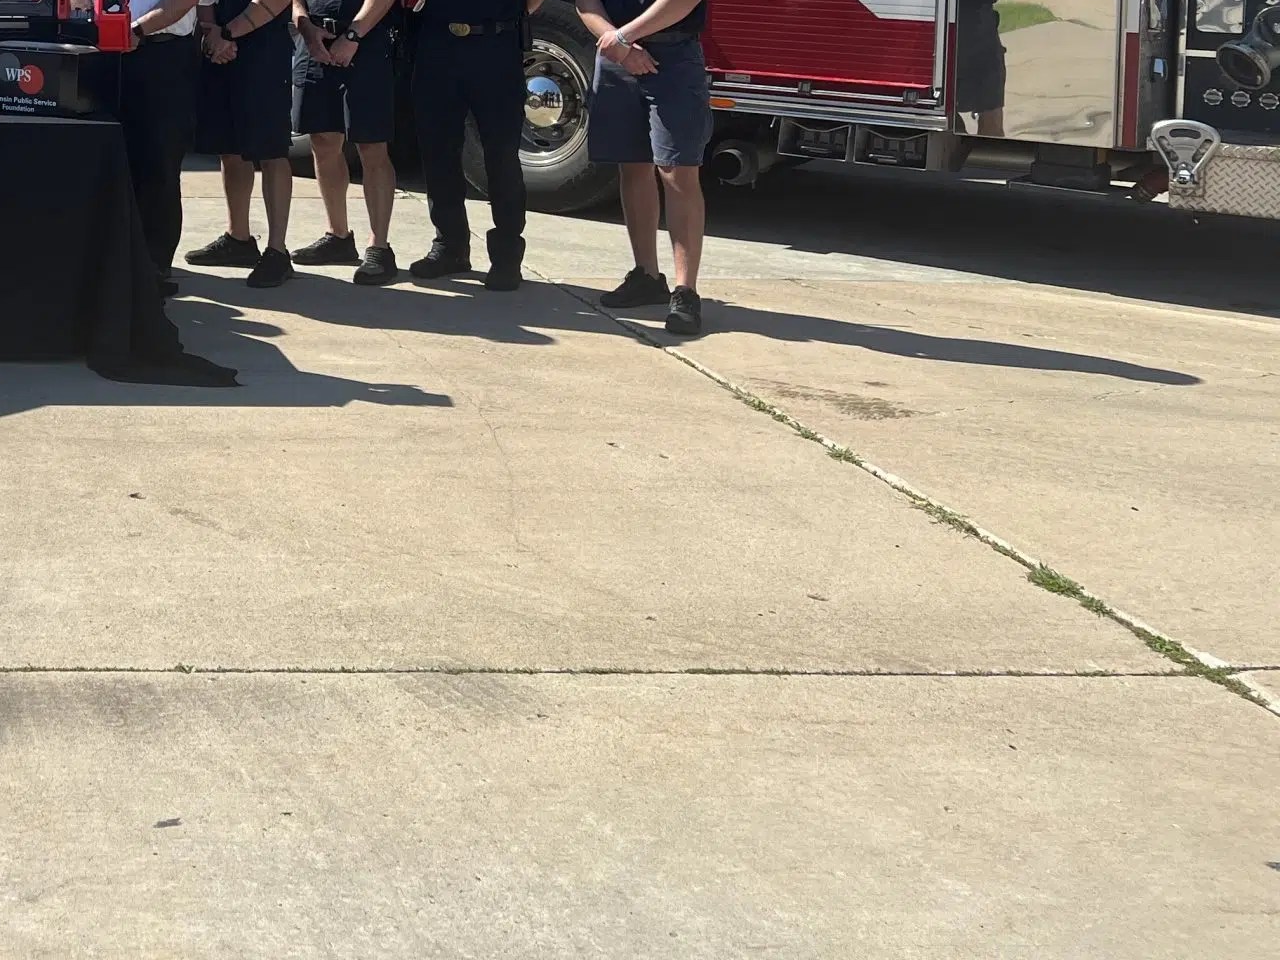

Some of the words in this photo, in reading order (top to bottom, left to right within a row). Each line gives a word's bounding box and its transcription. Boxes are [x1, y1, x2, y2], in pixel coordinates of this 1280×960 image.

[5, 67, 32, 83] WPS
[13, 96, 32, 105] Public
[33, 98, 57, 107] Service
[2, 103, 35, 113] Foundation
